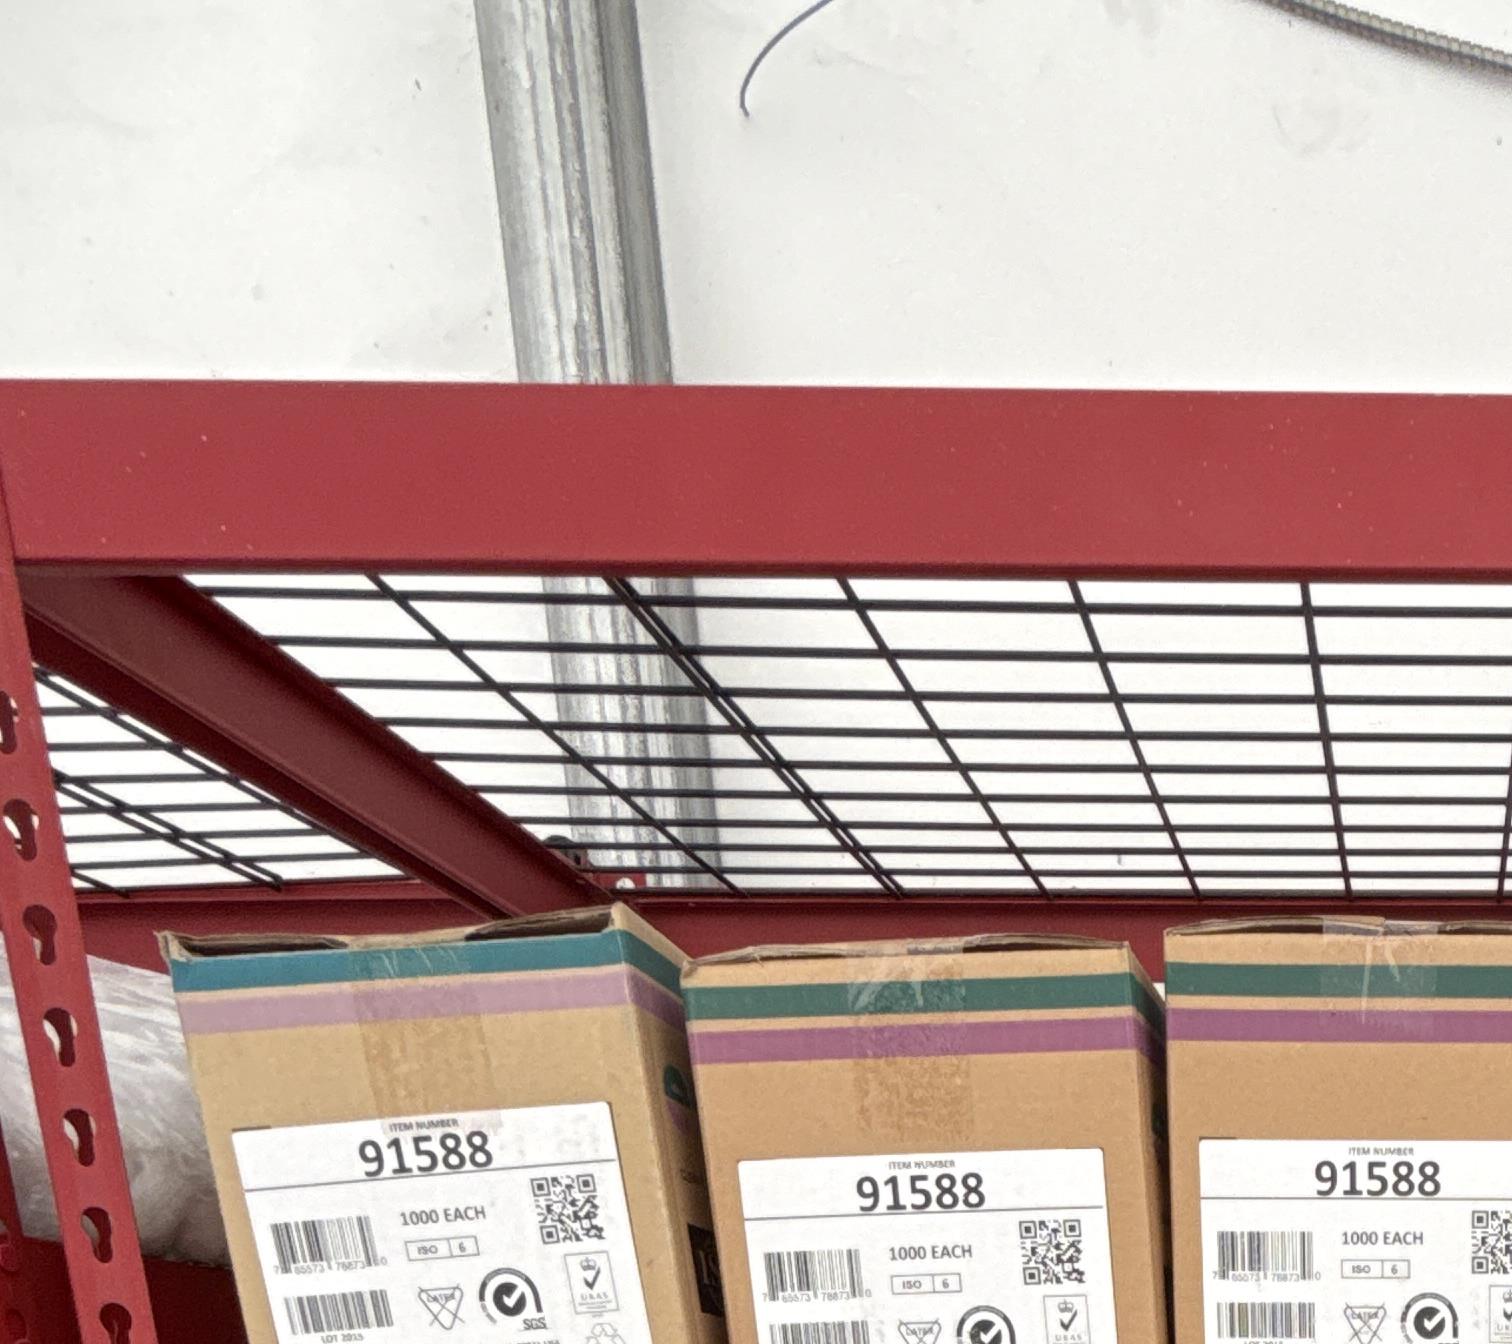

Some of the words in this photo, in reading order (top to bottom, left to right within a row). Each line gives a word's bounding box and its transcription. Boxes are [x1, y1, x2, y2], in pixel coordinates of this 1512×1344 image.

[357, 1130, 495, 1178] 91588
[1315, 1161, 1441, 1197] 91588
[856, 1172, 987, 1213] 91588
[400, 1209, 440, 1227] 1000
[443, 1205, 487, 1223] EACH
[1342, 1232, 1378, 1245] 1000
[1383, 1231, 1423, 1245] EACH
[417, 1244, 438, 1255] ISO
[890, 1246, 927, 1261] 1000
[931, 1244, 973, 1260] EACH
[1352, 1265, 1370, 1274] ISO
[1391, 1264, 1398, 1275] 6
[903, 1280, 922, 1290] ISO
[942, 1278, 949, 1289] 6
[523, 1317, 546, 1330] SGS
